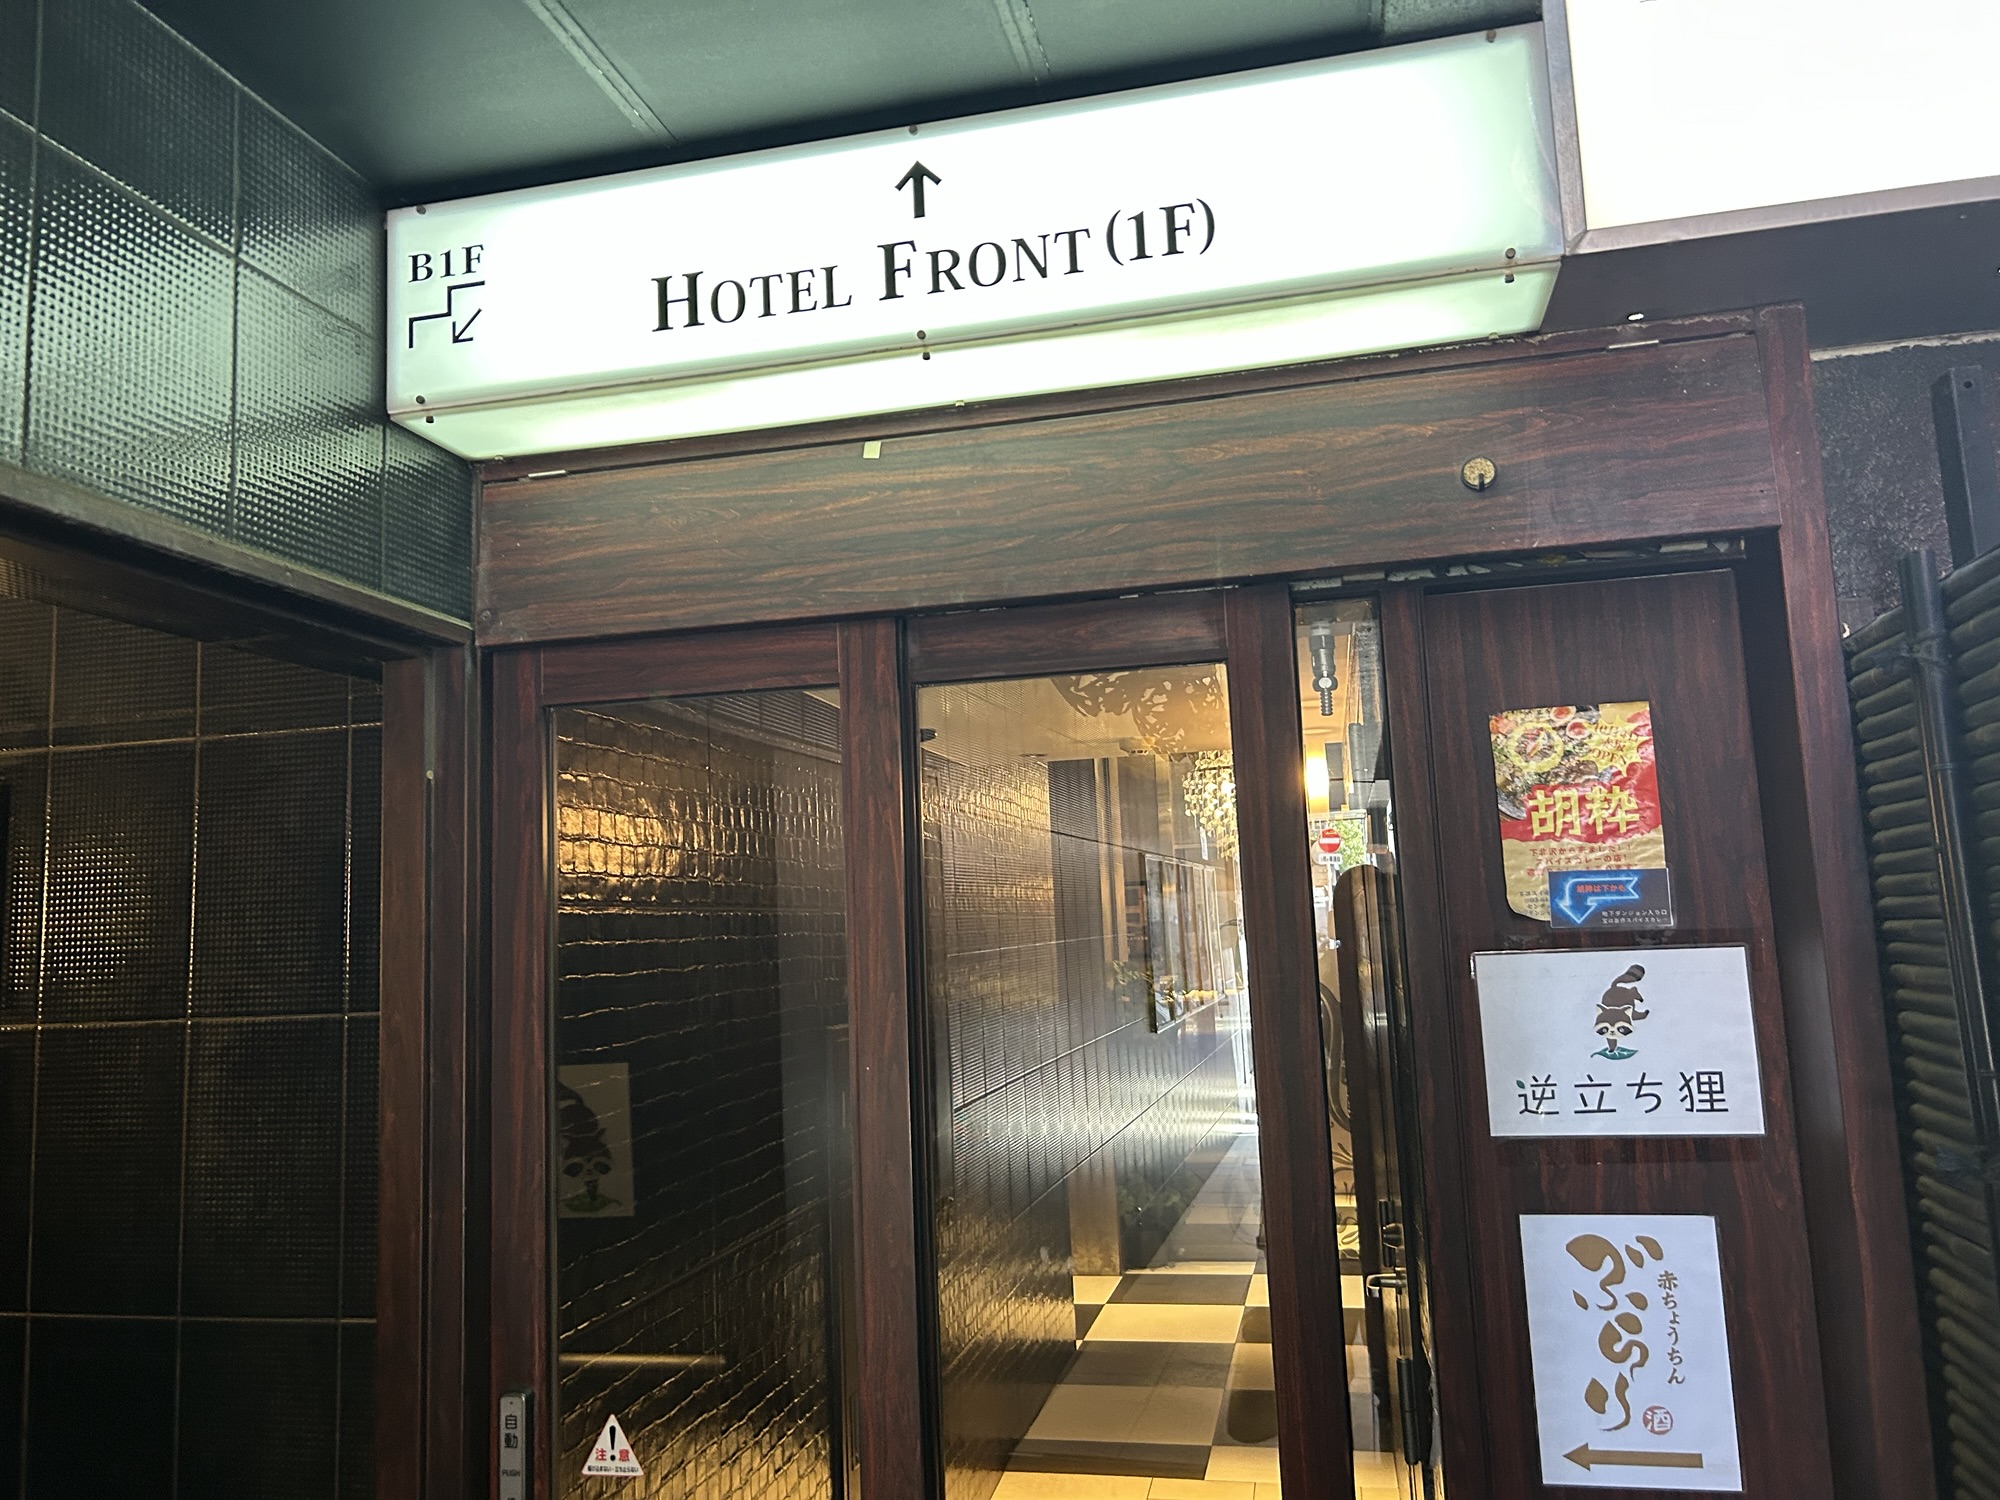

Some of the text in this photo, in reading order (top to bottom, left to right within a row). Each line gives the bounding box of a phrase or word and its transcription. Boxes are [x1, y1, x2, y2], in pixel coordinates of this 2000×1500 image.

[408, 244, 484, 283] B1F
[651, 198, 1216, 332] HOTEL FRONT (1F)
[1529, 785, 1640, 837] 胡粋
[1516, 1071, 1729, 1115] 逆立ち狸
[1566, 1233, 1664, 1432] ぶらり
[1657, 1270, 1686, 1385] 赤ちょうちん
[504, 1414, 518, 1448] 自動
[1645, 1407, 1673, 1433] 酒
